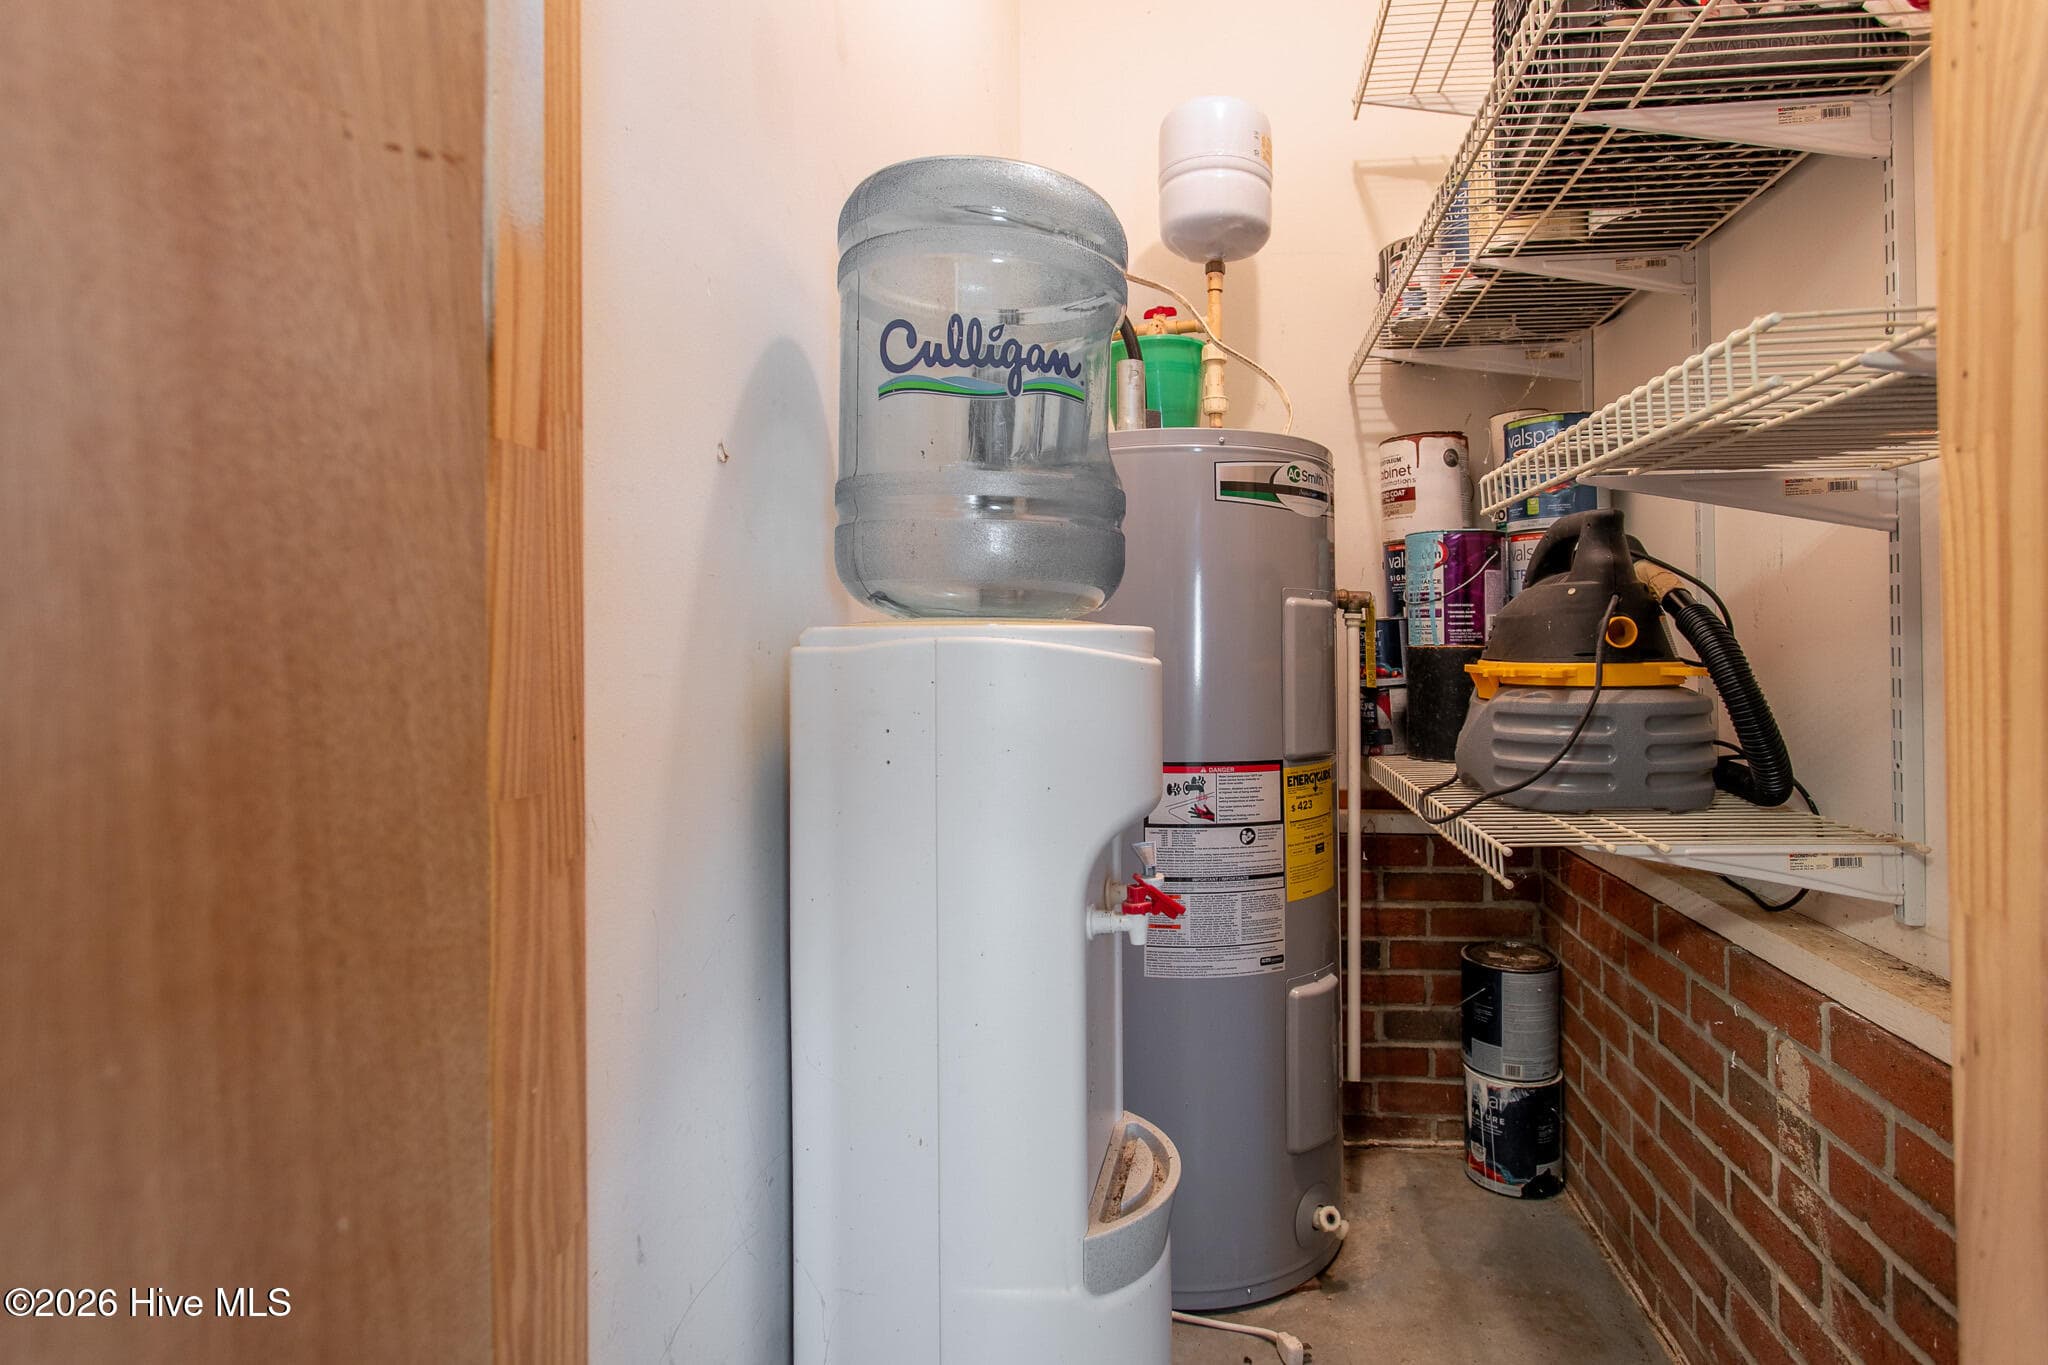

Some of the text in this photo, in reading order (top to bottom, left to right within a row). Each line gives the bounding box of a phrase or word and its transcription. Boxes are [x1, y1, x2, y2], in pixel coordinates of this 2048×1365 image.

[879, 313, 1082, 397] Culligan
[1302, 470, 1324, 486] Smith
[1297, 800, 1313, 810] 423
